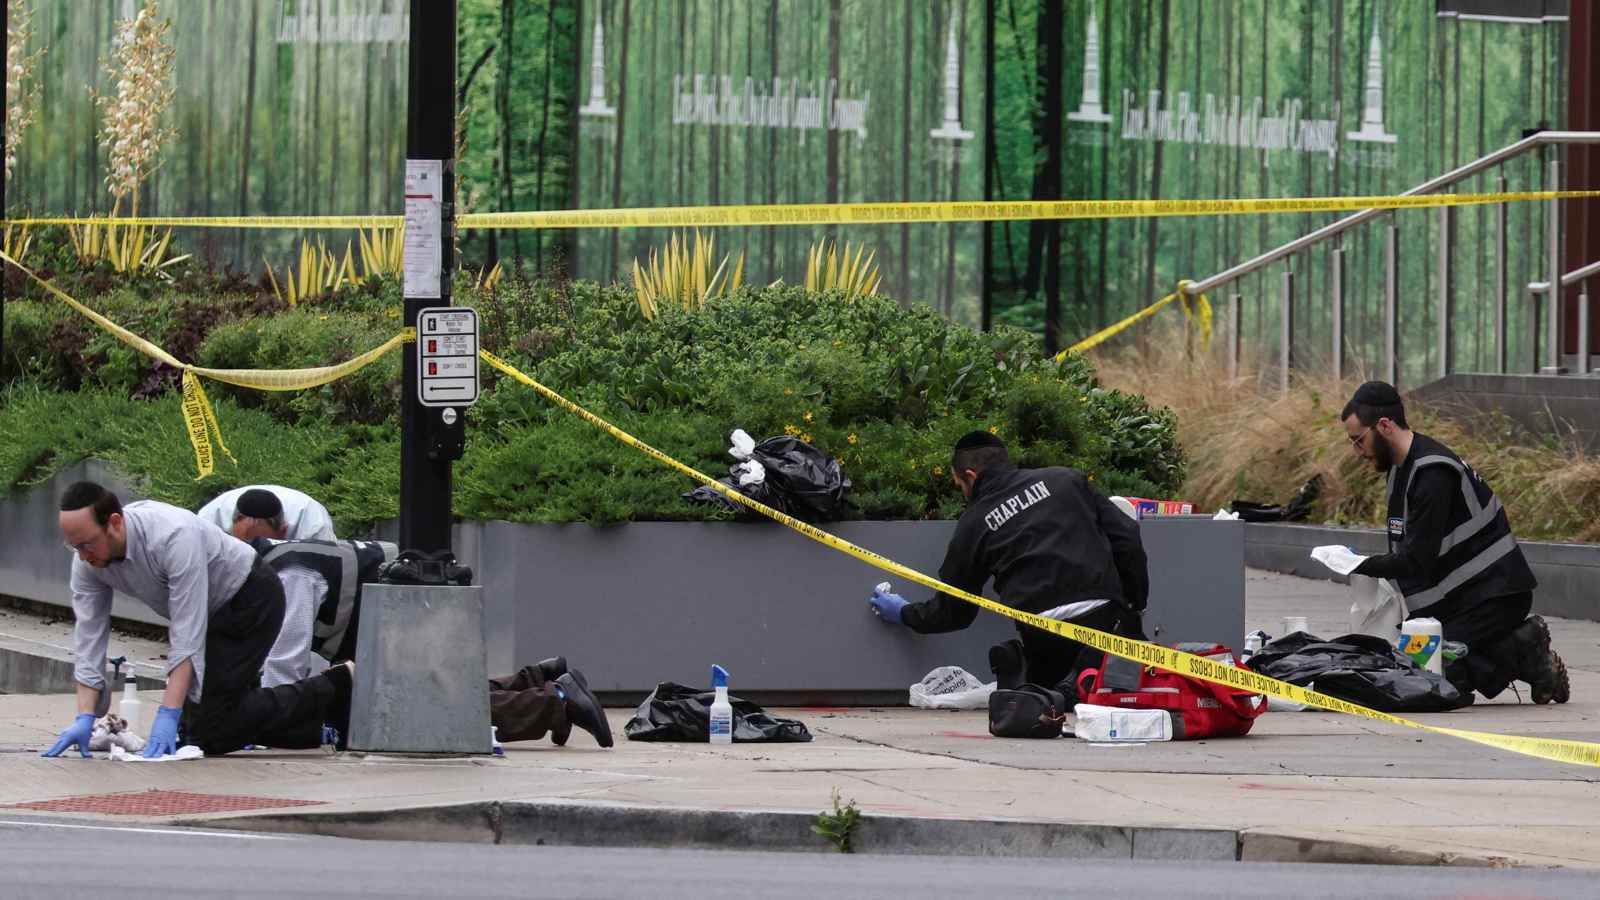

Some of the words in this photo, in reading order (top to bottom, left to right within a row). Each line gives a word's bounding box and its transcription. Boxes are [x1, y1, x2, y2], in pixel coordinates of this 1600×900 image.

[186, 403, 201, 417] NOT
[191, 418, 204, 428] DO
[194, 429, 207, 444] LINE
[199, 445, 210, 468] POLICE
[984, 480, 1051, 531] CHAPLAIN
[1073, 628, 1097, 647] CROSS
[1098, 634, 1112, 650] NOT
[1113, 638, 1123, 653] DO
[1125, 640, 1140, 656] LINE
[1142, 644, 1165, 665] POLICE
[1190, 658, 1213, 677] CROSS
[1214, 664, 1228, 681] NOT
[1229, 668, 1239, 683] DO
[1240, 671, 1256, 687] LINE
[1257, 676, 1281, 695] POLICE
